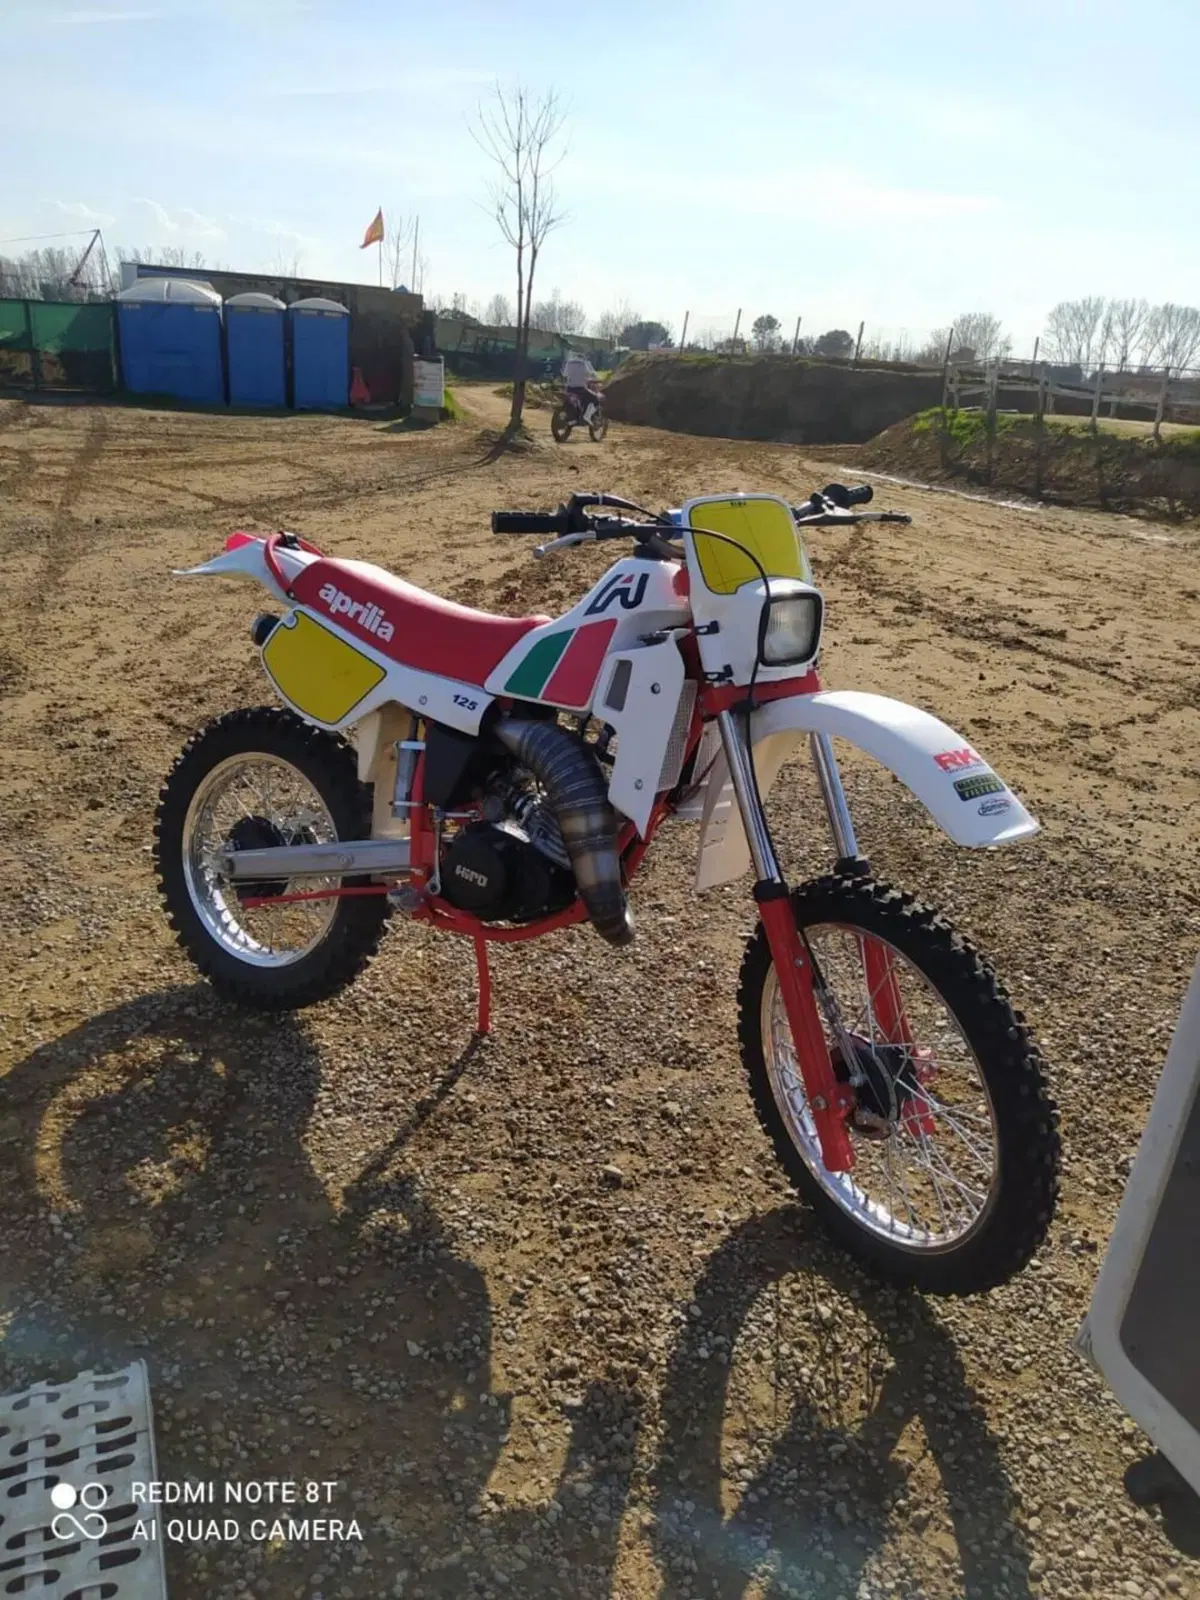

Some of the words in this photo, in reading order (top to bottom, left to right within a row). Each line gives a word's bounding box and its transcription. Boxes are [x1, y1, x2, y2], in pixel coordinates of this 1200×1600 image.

[318, 582, 395, 642] aprilia
[453, 694, 479, 711] 125
[933, 749, 981, 771] RK
